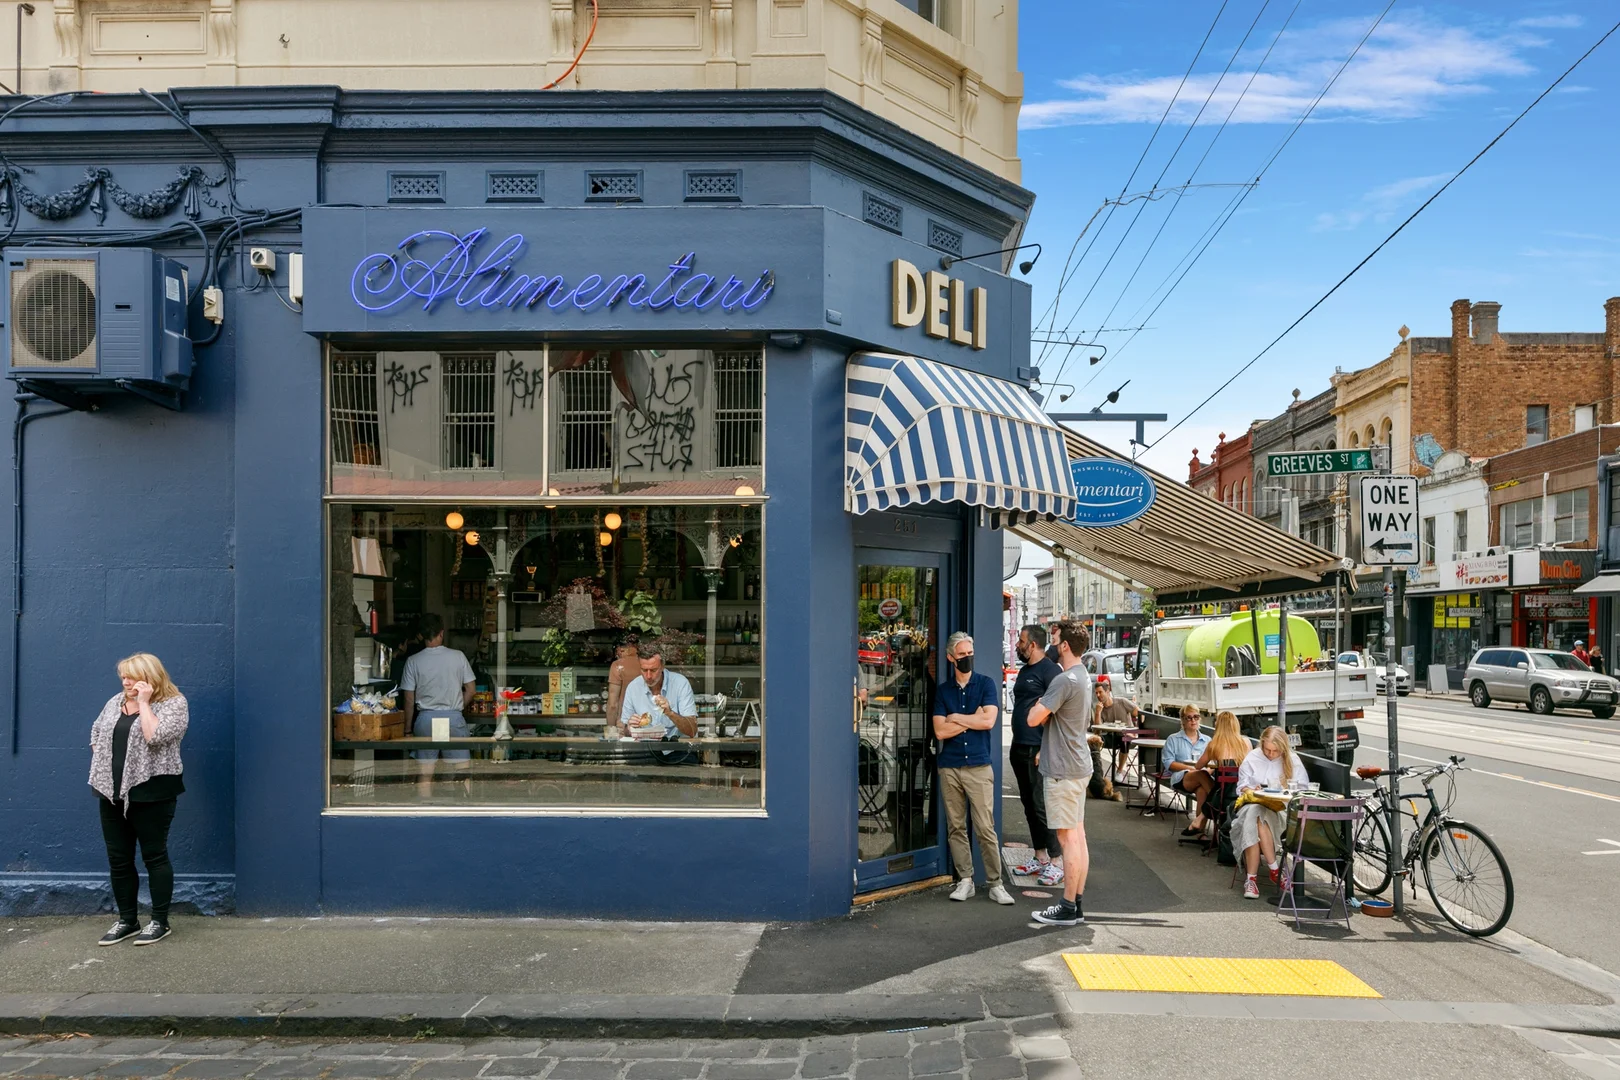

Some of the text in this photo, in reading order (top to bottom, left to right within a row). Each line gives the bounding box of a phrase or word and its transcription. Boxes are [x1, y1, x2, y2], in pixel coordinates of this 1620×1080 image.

[351, 226, 774, 313] Alimentari
[892, 258, 987, 351] DELI
[1073, 466, 1104, 474] UNSWICK
[1272, 453, 1349, 474] GREEVES ST
[1074, 481, 1144, 497] imentari
[1370, 485, 1409, 504] ONE
[894, 518, 918, 534] 251
[1368, 513, 1412, 531] WAY
[1541, 560, 1581, 578] Yum Cha
[867, 624, 929, 651] DELICATESSEN
